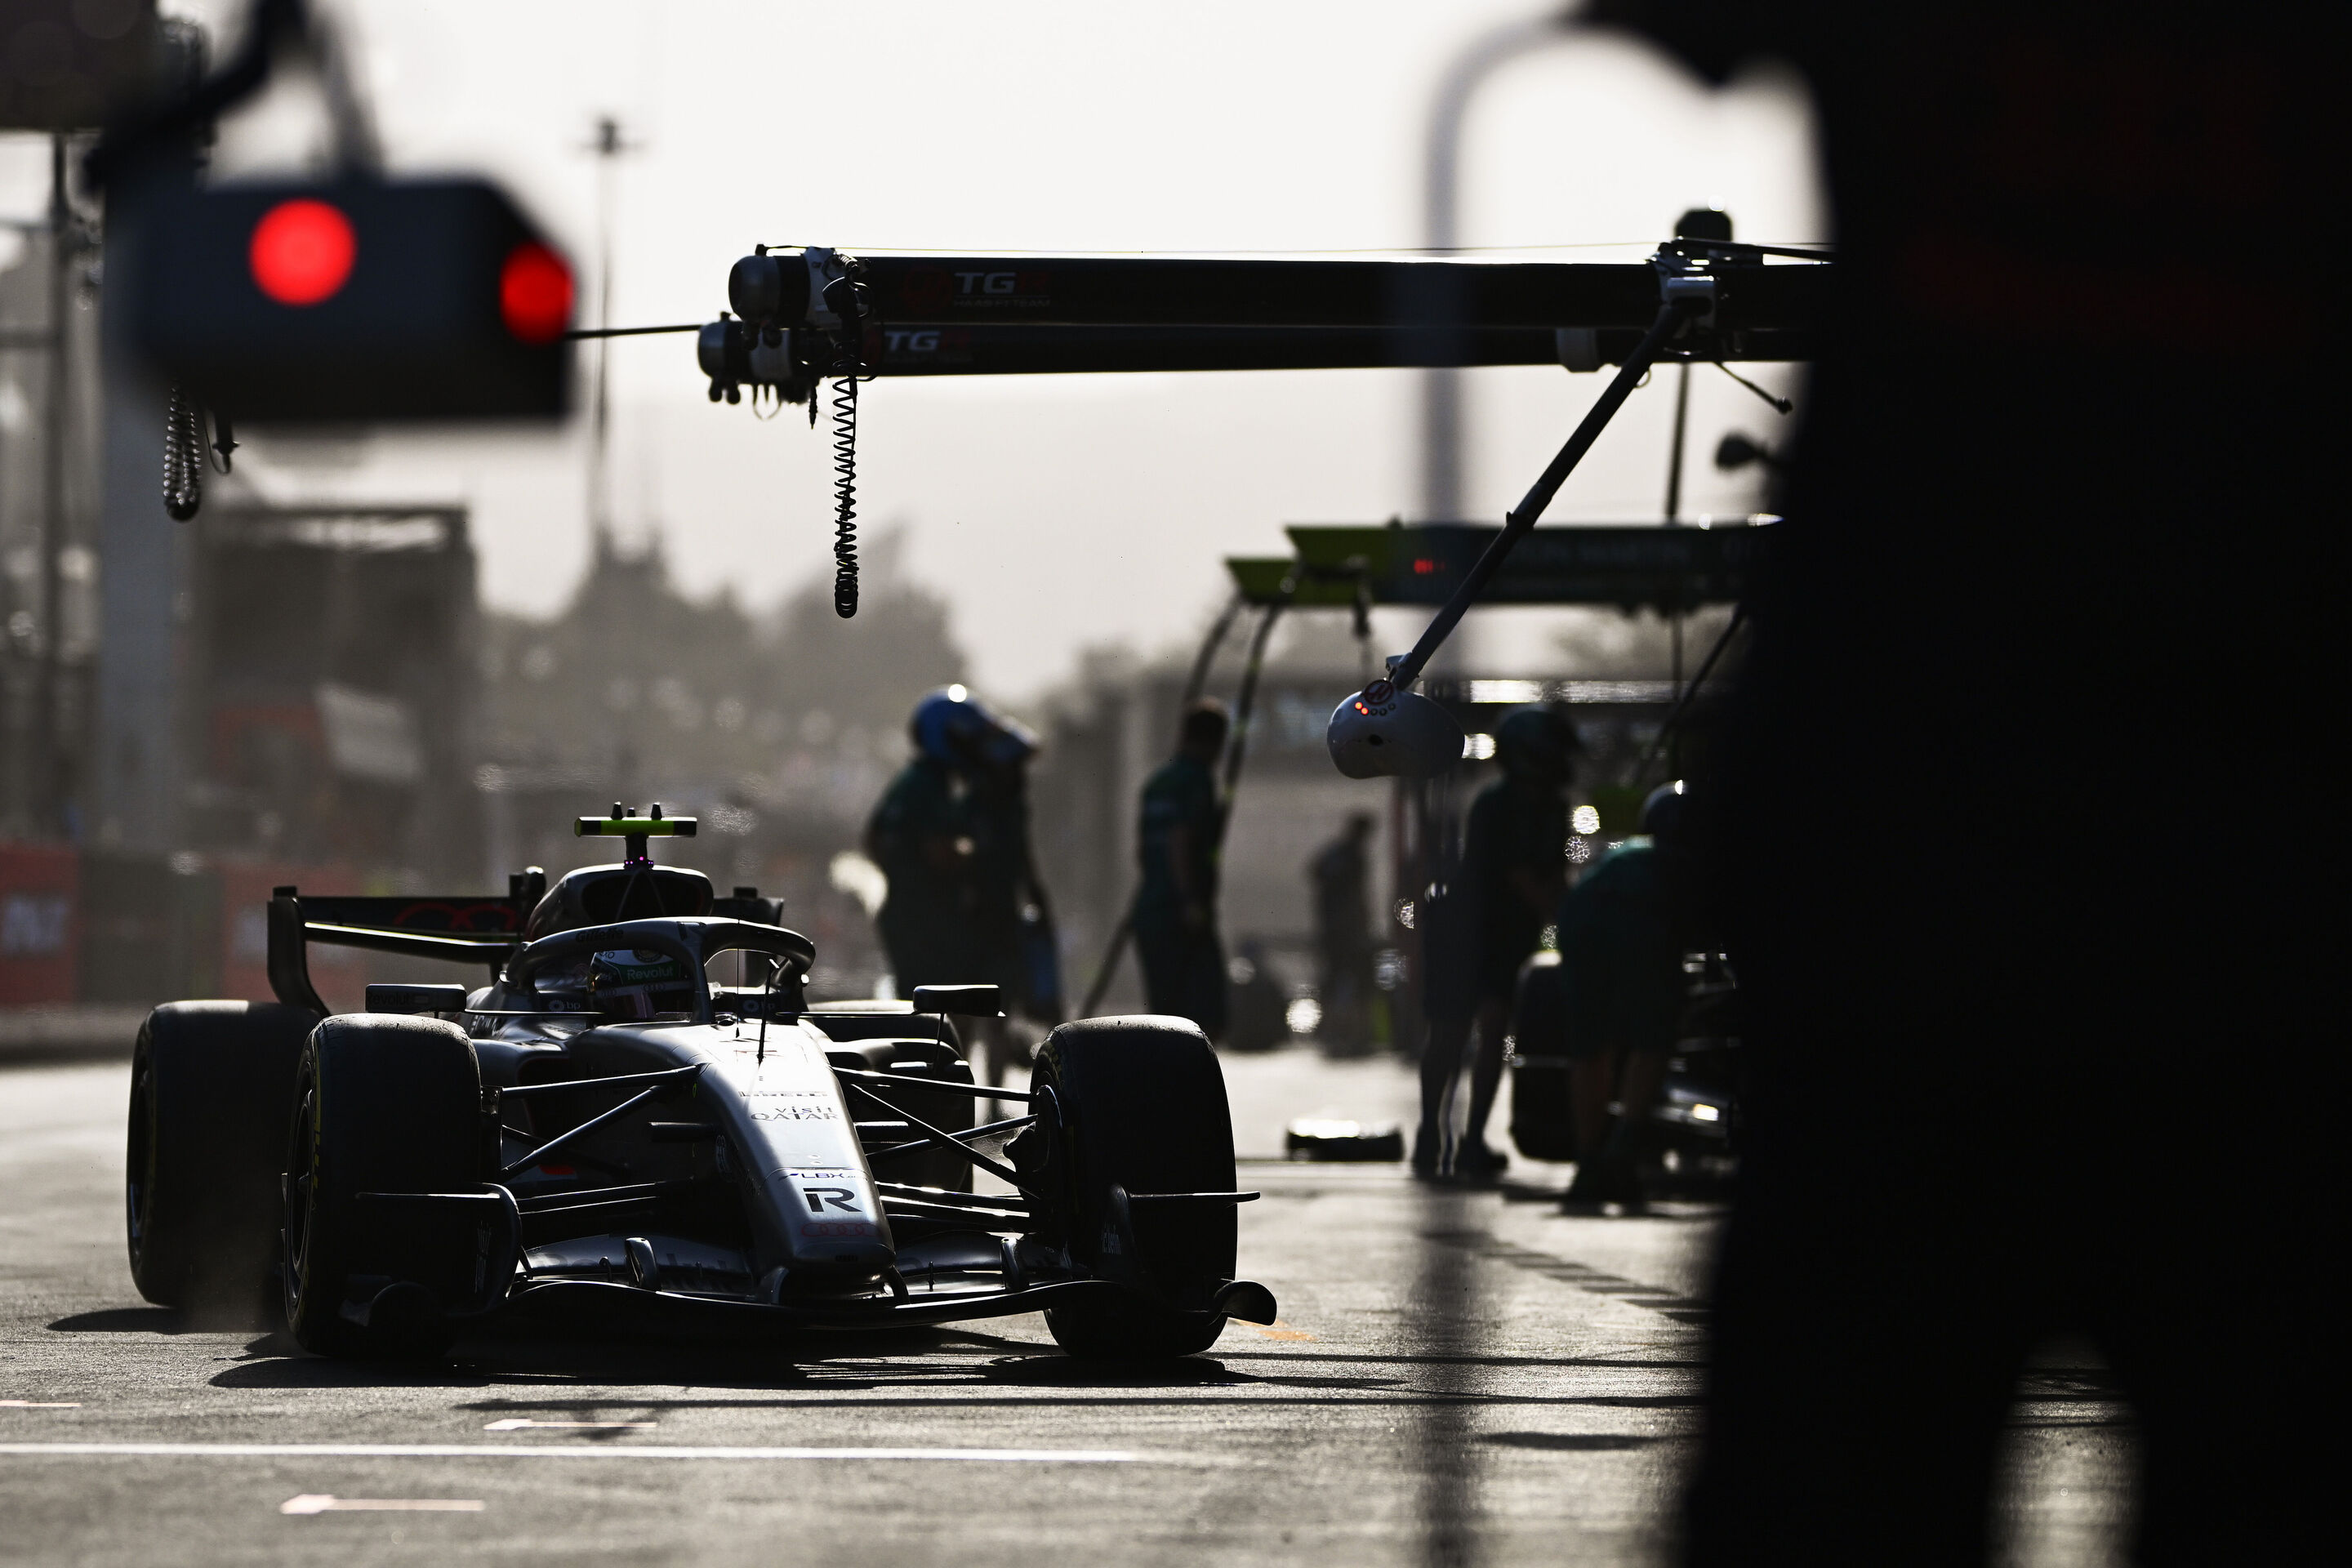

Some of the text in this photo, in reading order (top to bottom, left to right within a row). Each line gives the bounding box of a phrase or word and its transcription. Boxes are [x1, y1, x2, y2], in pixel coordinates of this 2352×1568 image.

[626, 966, 674, 981] Revolut
[366, 991, 412, 1005] Revolut
[565, 1000, 581, 1012] bp
[751, 1112, 839, 1122] QATAR
[802, 1187, 863, 1213] R
